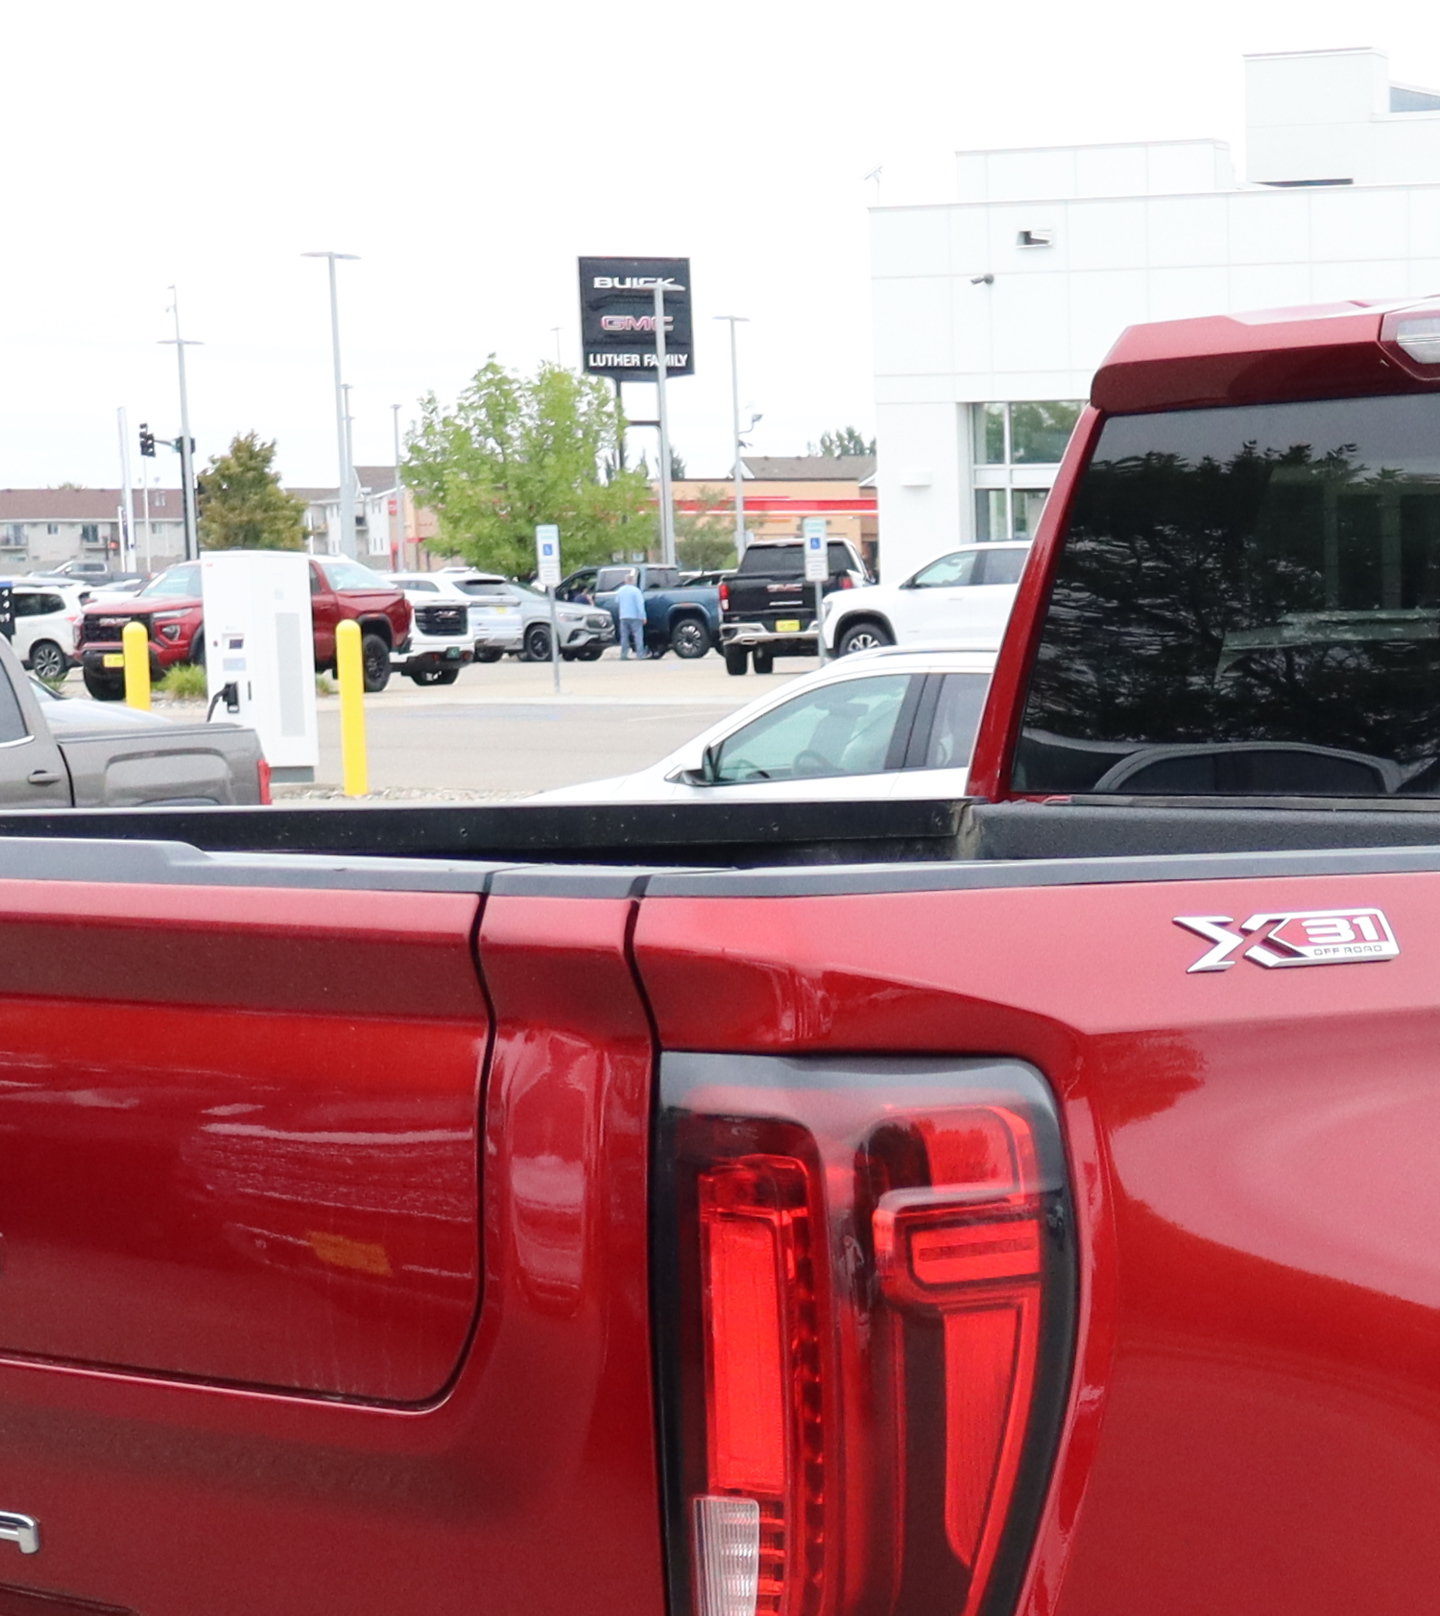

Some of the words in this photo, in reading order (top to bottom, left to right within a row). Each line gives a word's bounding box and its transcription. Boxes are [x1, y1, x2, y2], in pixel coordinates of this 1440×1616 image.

[601, 315, 674, 331] GMC
[589, 353, 641, 367] LUTHER
[1313, 946, 1340, 957] OFF
[1344, 944, 1383, 955] ROAD
